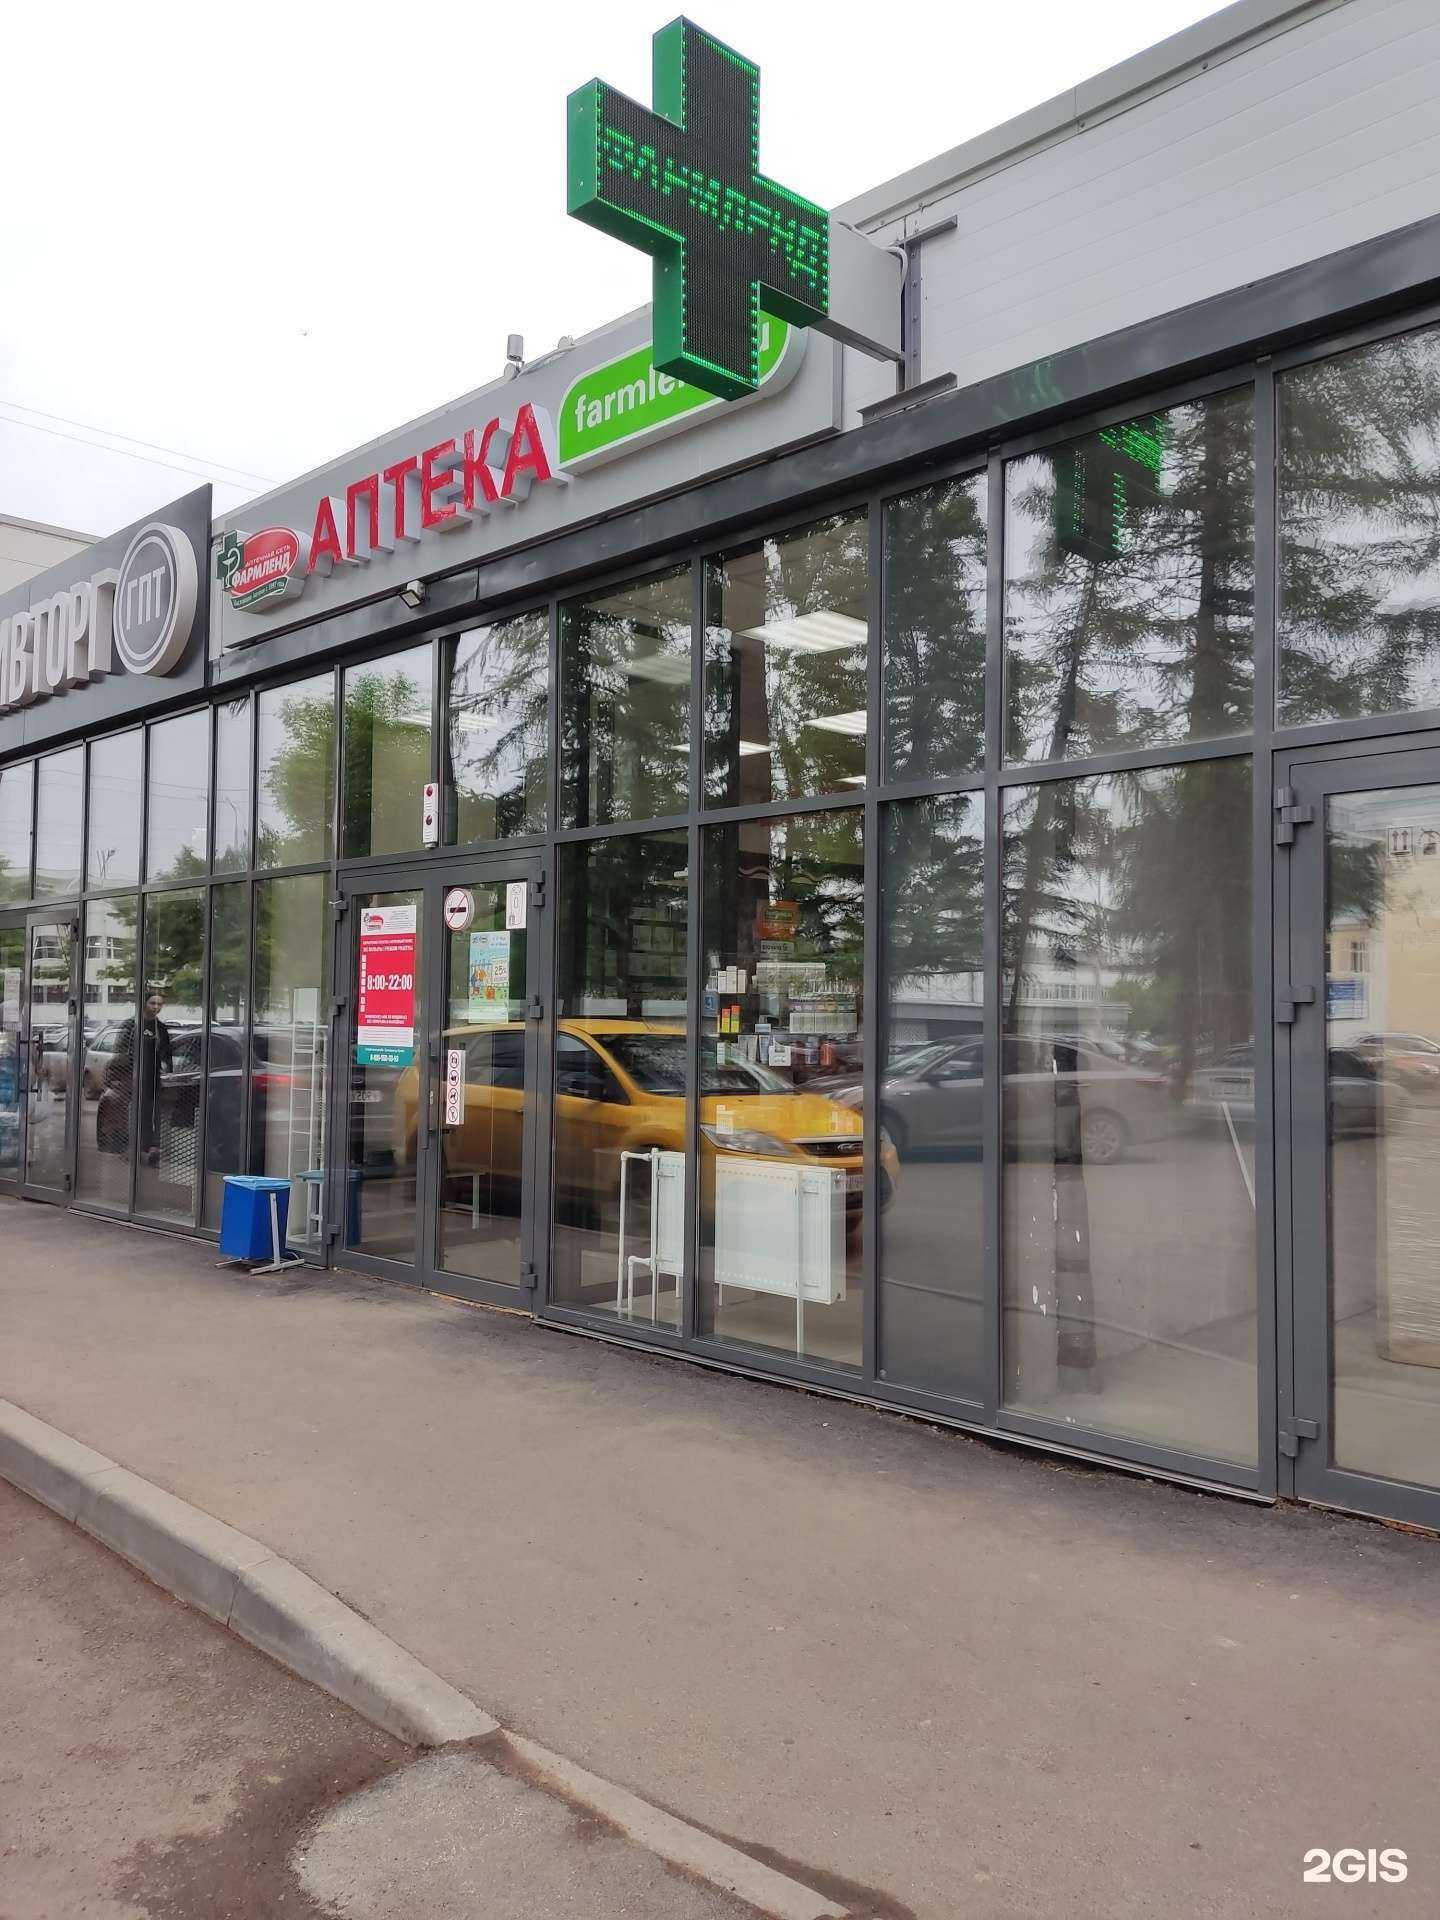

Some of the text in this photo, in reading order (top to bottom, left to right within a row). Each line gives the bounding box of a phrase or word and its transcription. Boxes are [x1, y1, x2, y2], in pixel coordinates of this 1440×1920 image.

[307, 402, 551, 575] АПТЕКА
[231, 551, 291, 587] ФАРМЛЕНД
[126, 566, 166, 630] ГПТ
[367, 974, 412, 991] 8:00-22:00
